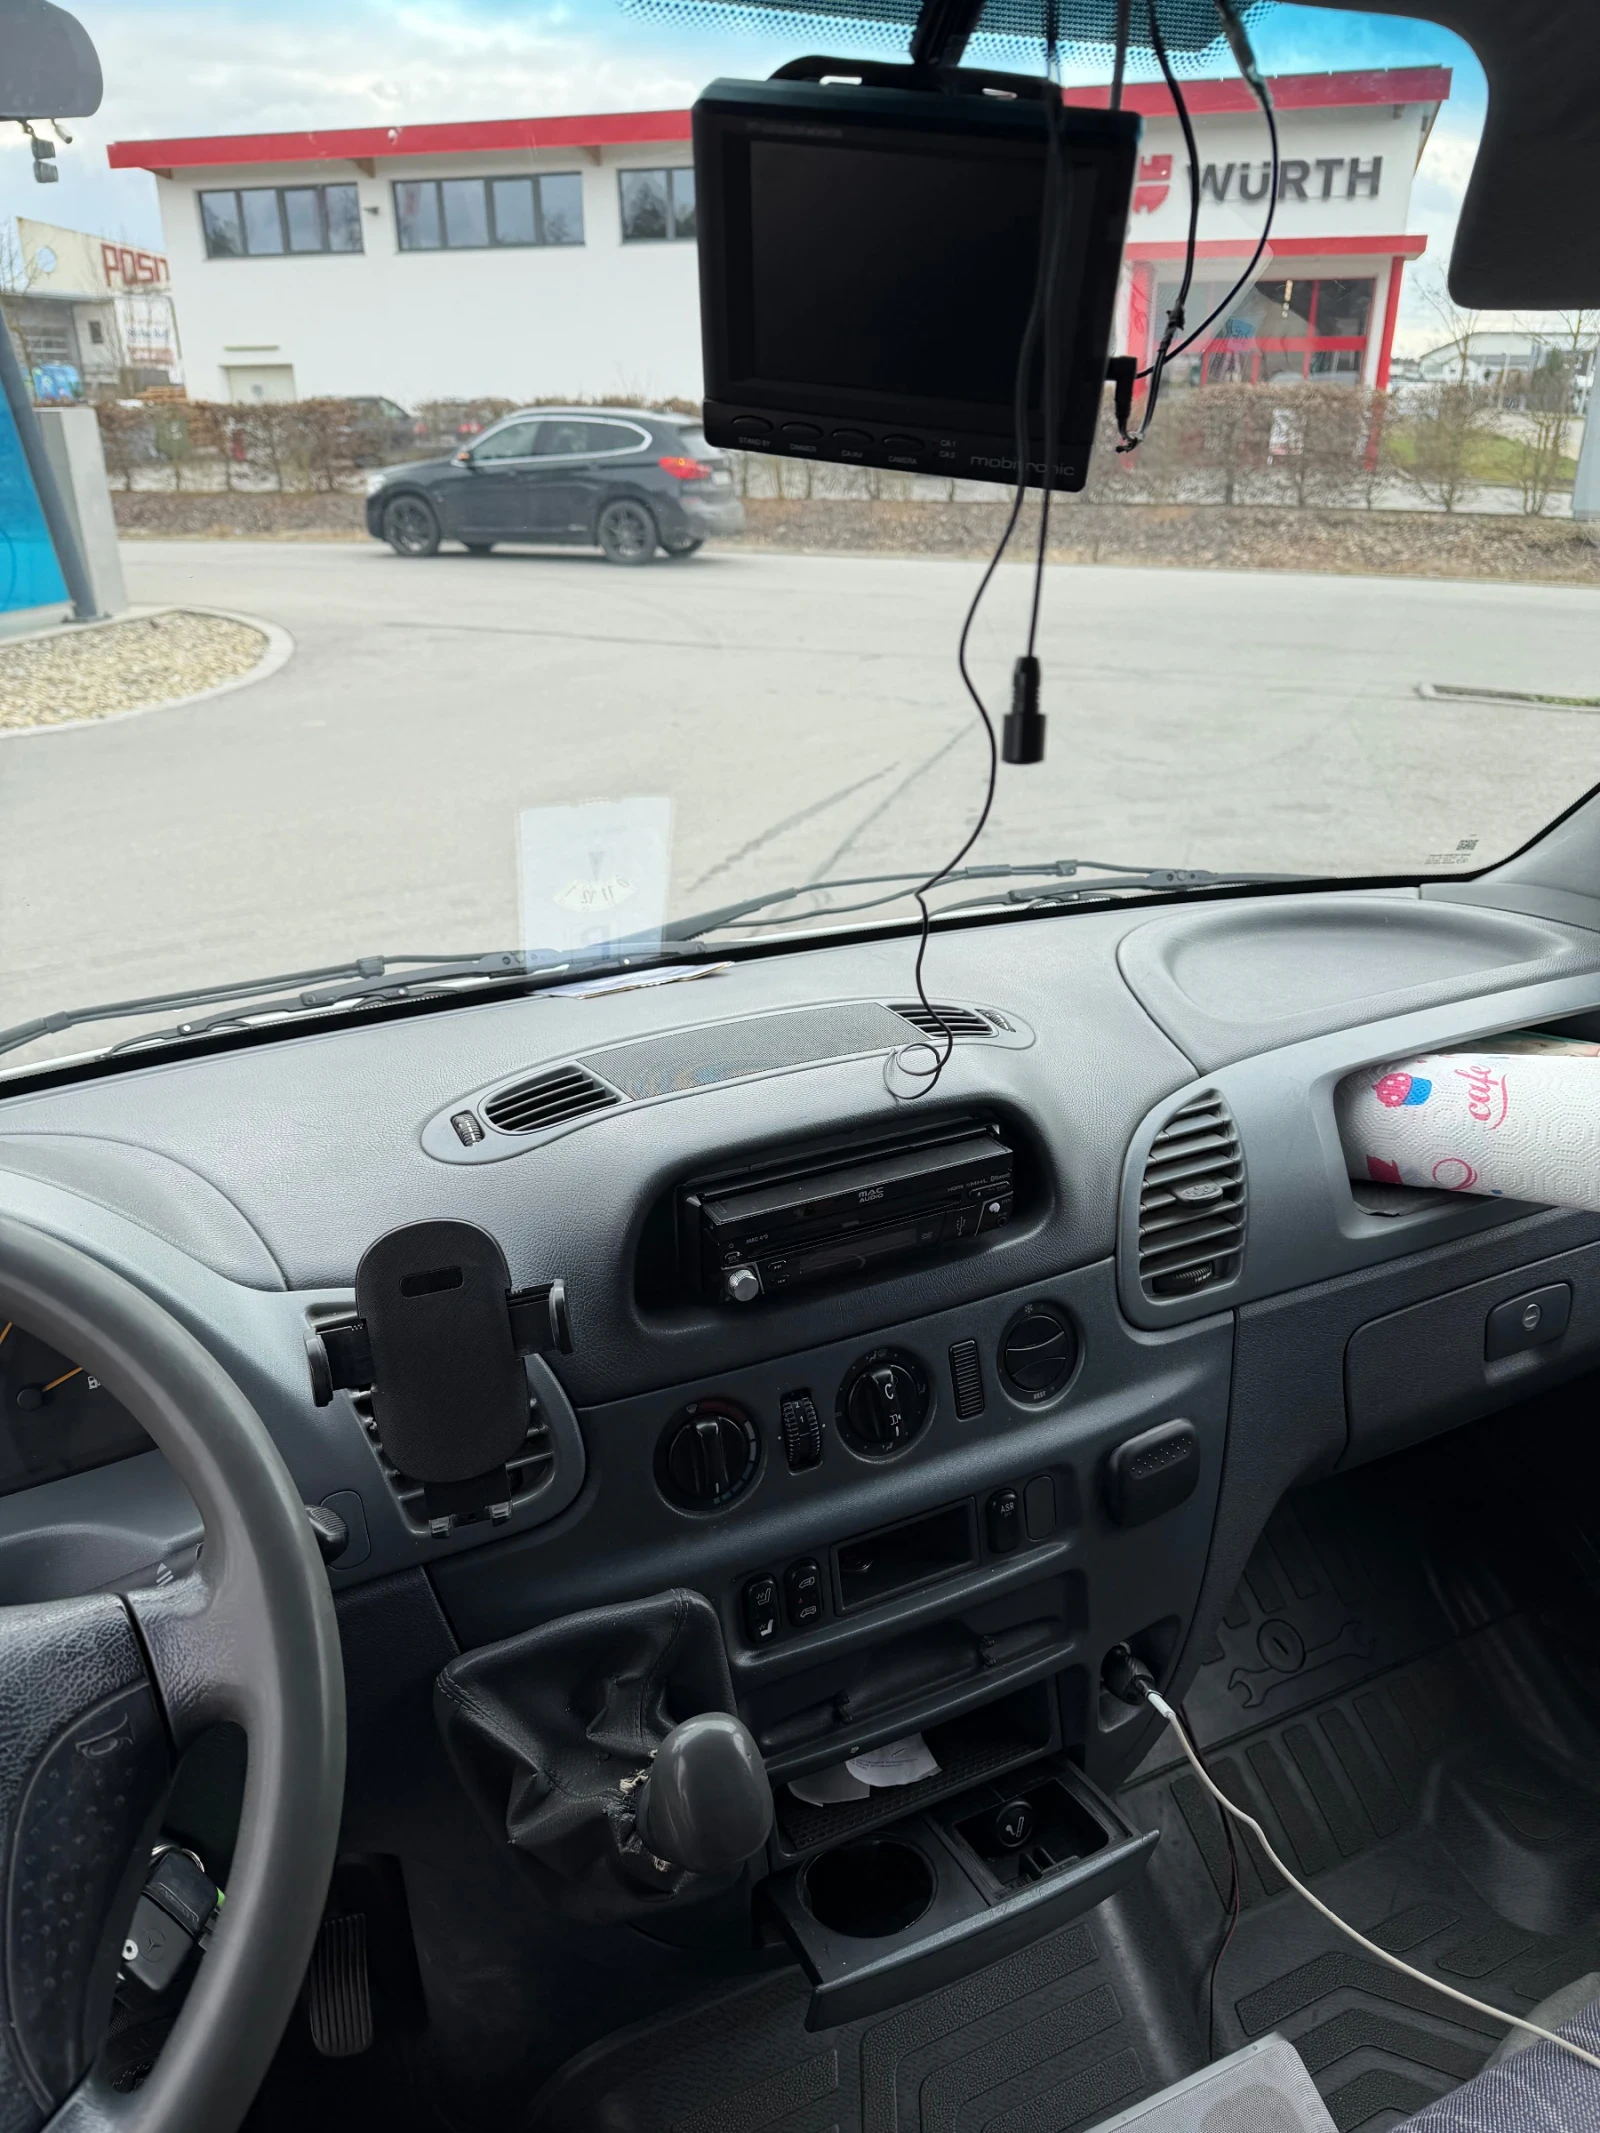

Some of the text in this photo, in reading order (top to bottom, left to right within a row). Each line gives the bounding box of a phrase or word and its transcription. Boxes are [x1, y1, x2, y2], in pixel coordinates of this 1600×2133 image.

[1186, 156, 1383, 202] WÜRTH
[738, 436, 761, 446] STAND
[789, 443, 817, 453] DIMMER
[888, 455, 918, 465] CAMERA
[1454, 1066, 1499, 1121] cafe
[858, 1186, 884, 1198] MAC
[858, 1193, 884, 1203] AUDIO
[794, 1401, 801, 1409] 2
[799, 1415, 805, 1423] 1
[1001, 1501, 1015, 1514] ASR
